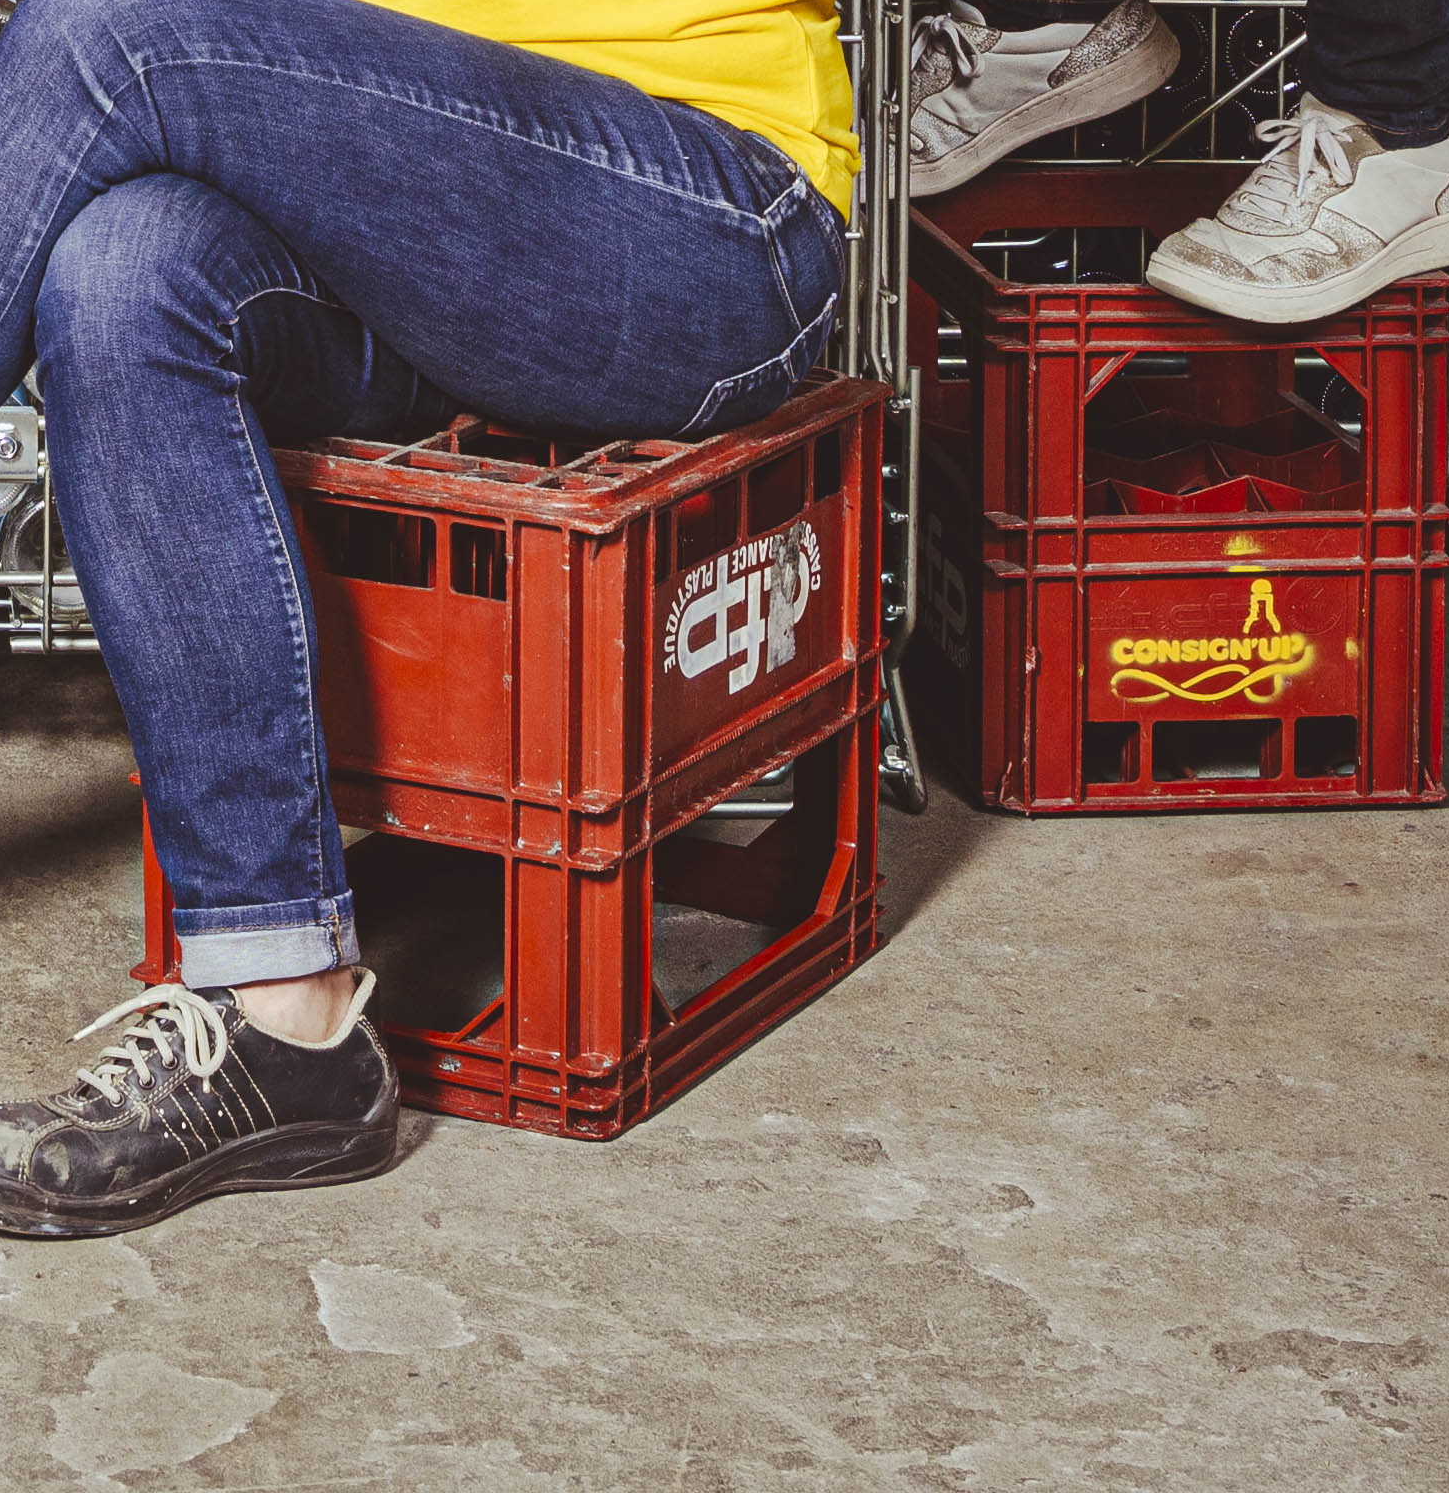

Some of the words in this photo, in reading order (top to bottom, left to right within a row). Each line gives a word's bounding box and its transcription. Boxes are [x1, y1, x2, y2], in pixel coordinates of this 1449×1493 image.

[731, 534, 781, 574] RANCE
[799, 521, 822, 592] CAISS
[663, 560, 713, 674] PLASTIQUE
[1112, 635, 1305, 666] CONSIGN'UP
